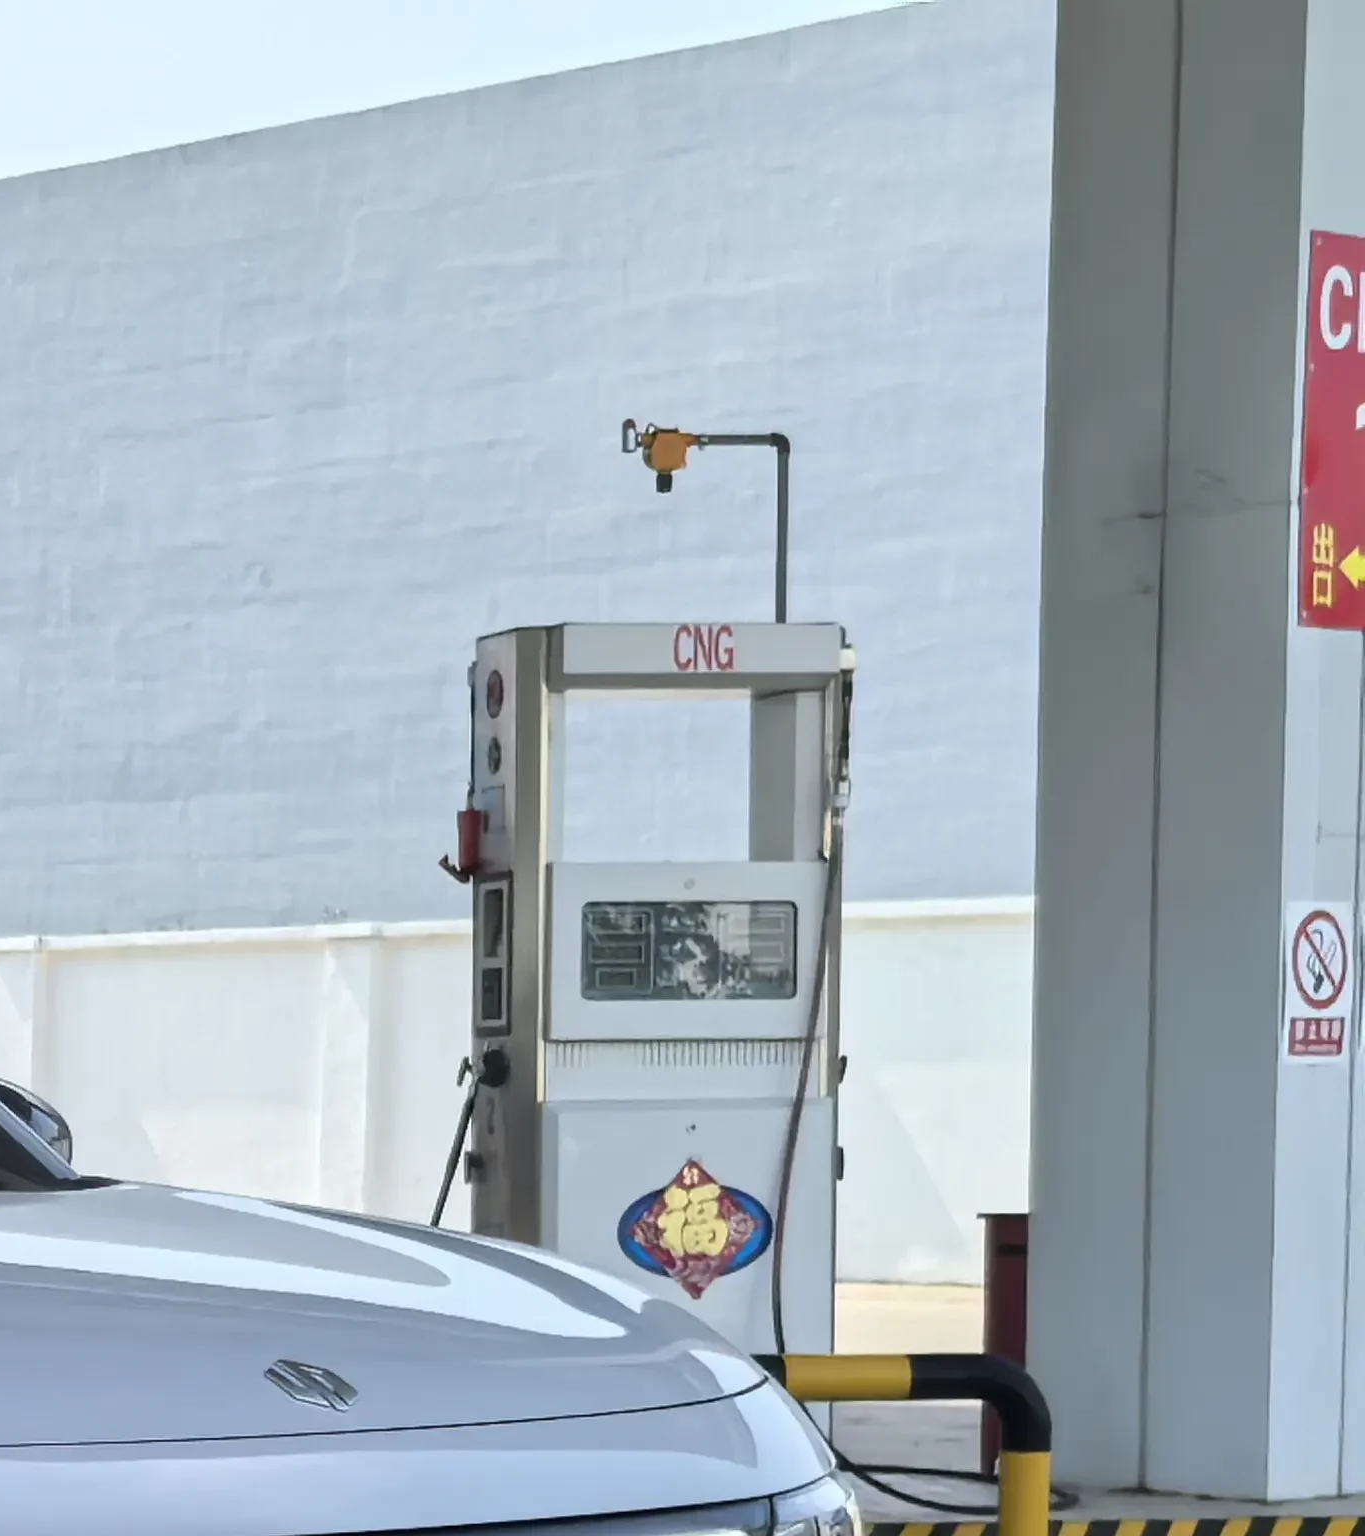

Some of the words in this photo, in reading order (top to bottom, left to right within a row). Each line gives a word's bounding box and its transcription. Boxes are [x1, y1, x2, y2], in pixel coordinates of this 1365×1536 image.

[1320, 264, 1365, 353] C
[1312, 522, 1335, 608] 出口
[674, 624, 733, 671] CNG
[657, 1183, 728, 1257] 福
